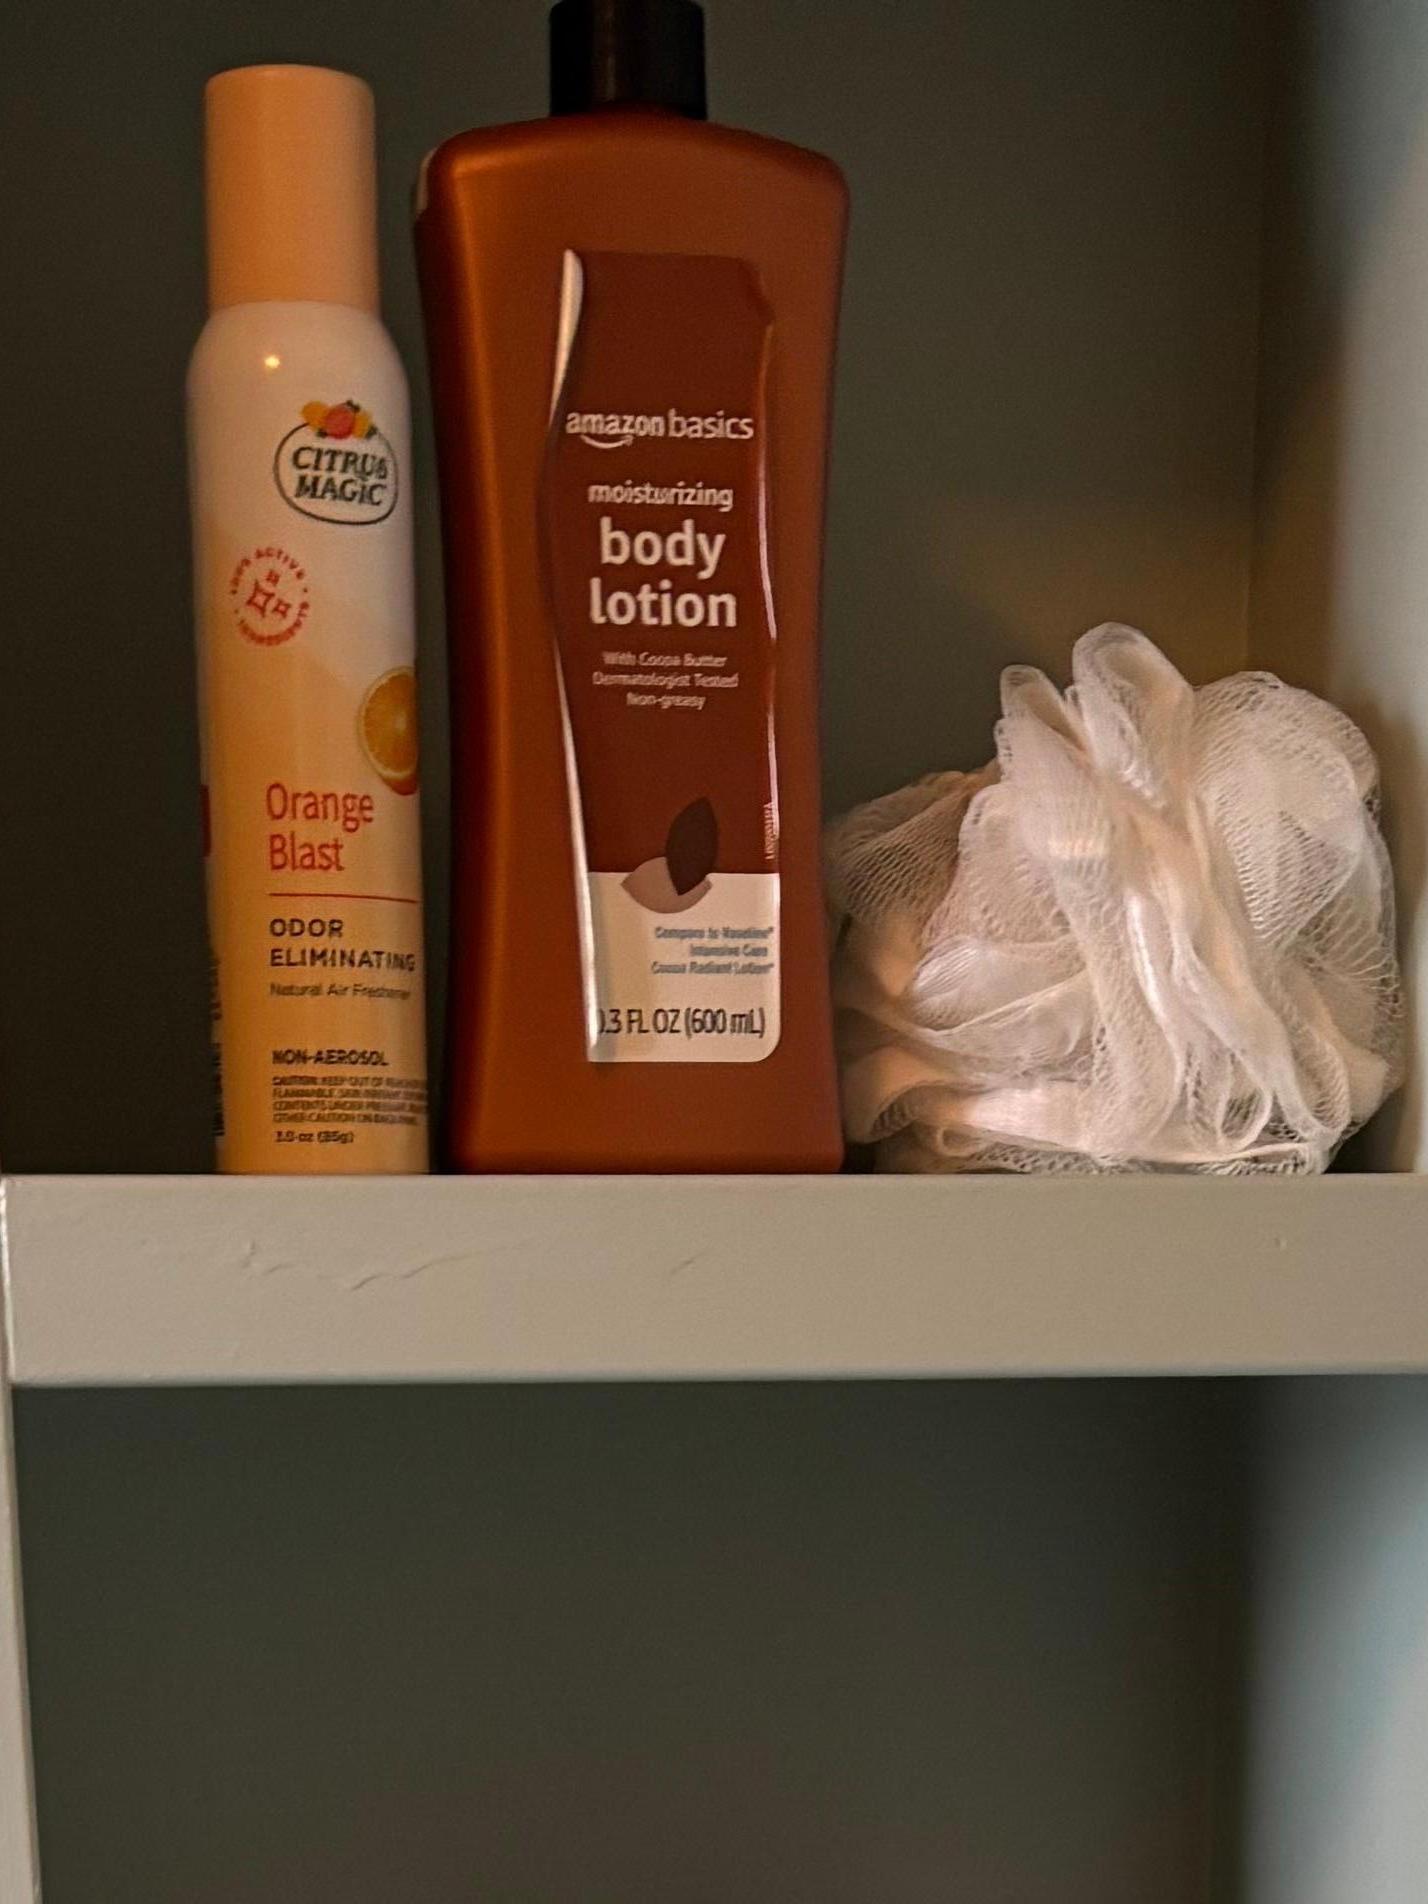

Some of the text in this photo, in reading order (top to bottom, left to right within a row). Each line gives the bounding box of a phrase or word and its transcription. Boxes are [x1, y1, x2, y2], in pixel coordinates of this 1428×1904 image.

[566, 409, 754, 439] amazon basics
[292, 446, 388, 481] CITRUS
[294, 475, 387, 506] MAGIC
[588, 480, 734, 512] moisturizing
[600, 516, 726, 579] body
[590, 577, 737, 627] lotion
[266, 782, 374, 833] Orange
[269, 831, 345, 872] Blast
[269, 918, 343, 938] ODOR
[269, 948, 416, 972] ELIMINATING
[627, 1009, 649, 1034] FL
[652, 1009, 681, 1034] OZ
[684, 1007, 726, 1039] (600
[272, 1050, 389, 1066] NON-AEROSOL
